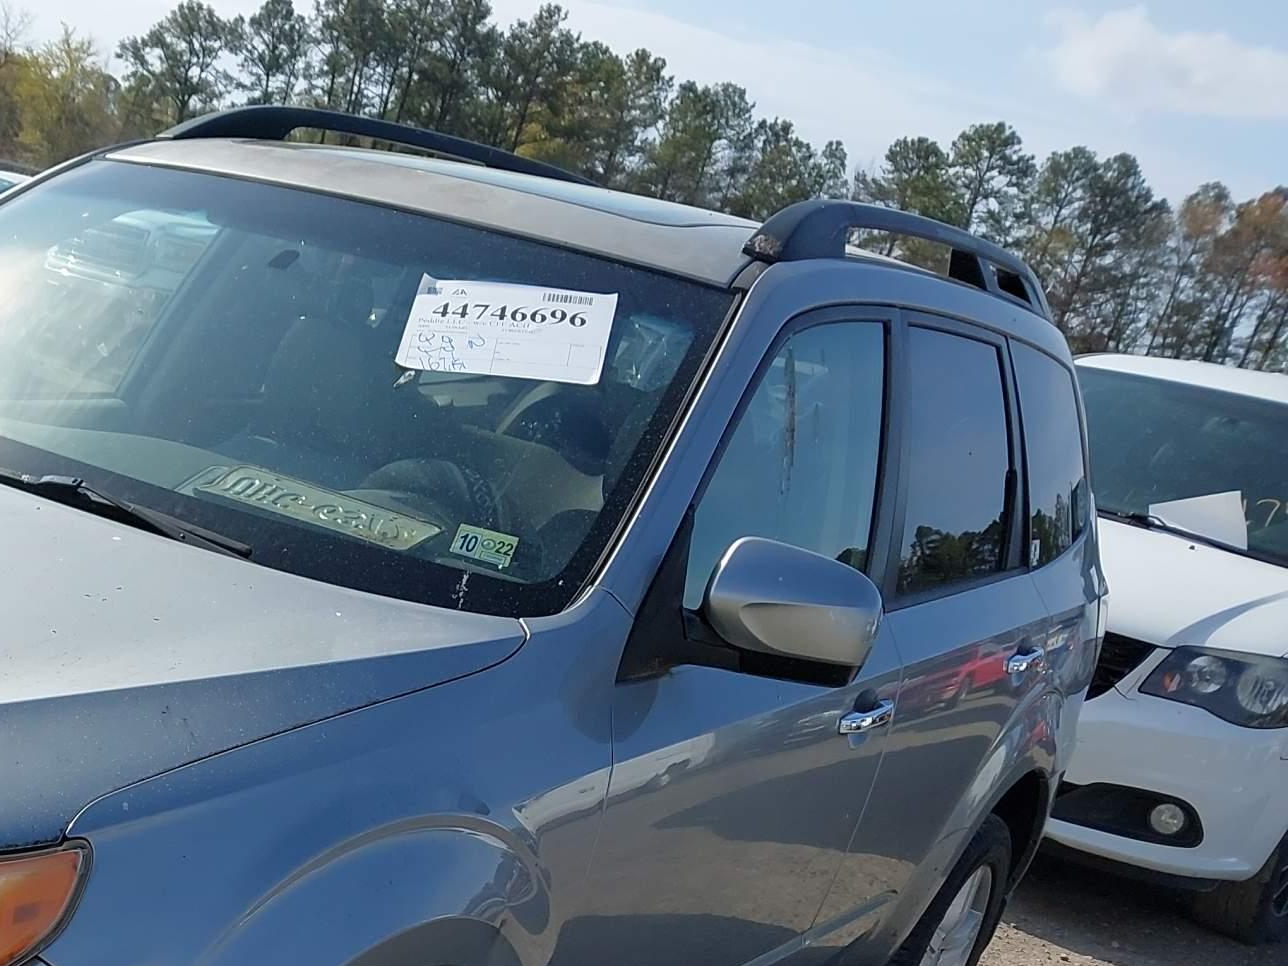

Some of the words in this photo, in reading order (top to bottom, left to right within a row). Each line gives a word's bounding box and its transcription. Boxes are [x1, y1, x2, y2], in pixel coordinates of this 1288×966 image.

[432, 301, 587, 328] 44746696
[459, 533, 479, 553] 10
[494, 540, 514, 557] 22
